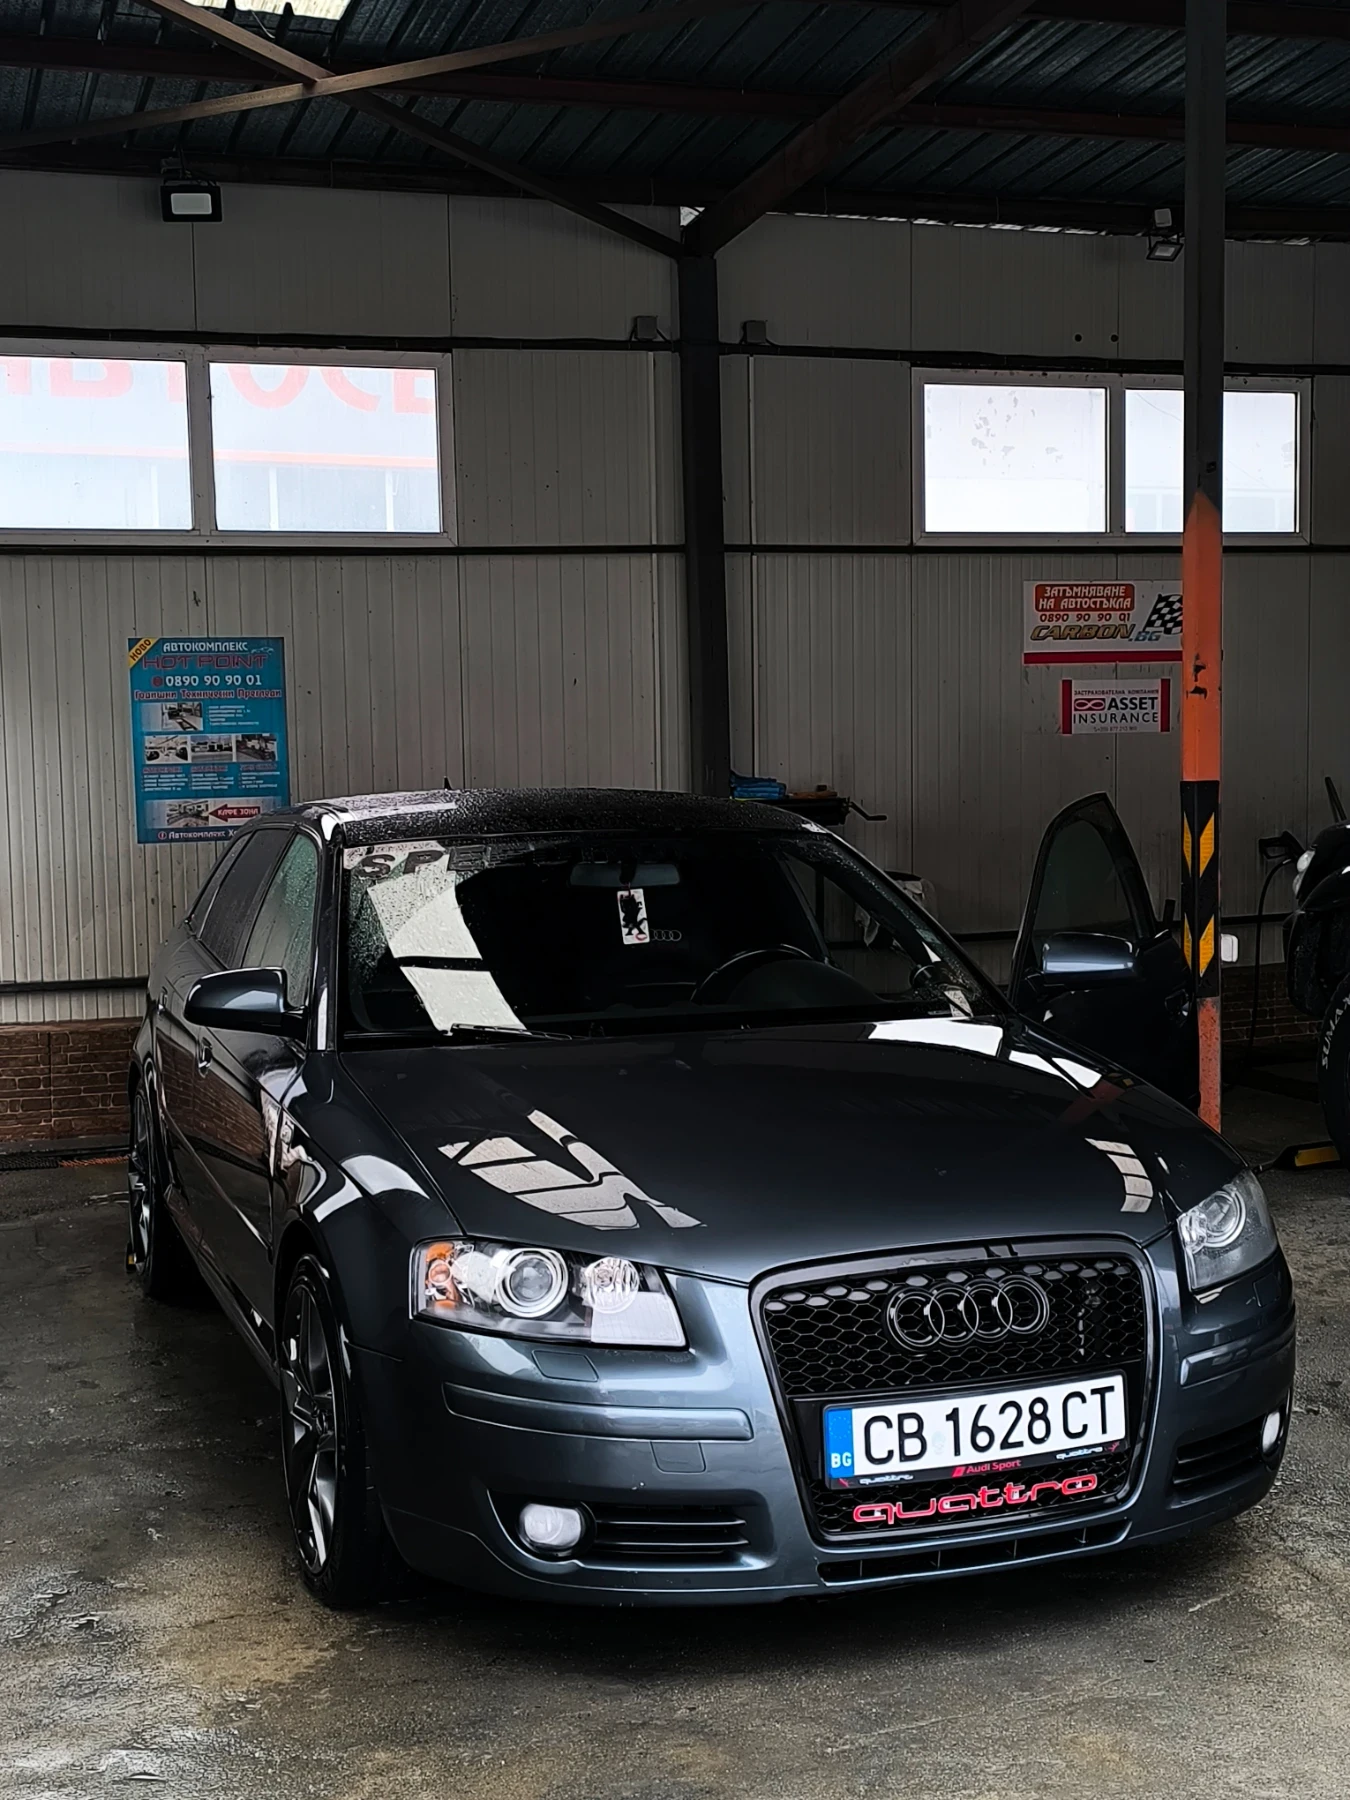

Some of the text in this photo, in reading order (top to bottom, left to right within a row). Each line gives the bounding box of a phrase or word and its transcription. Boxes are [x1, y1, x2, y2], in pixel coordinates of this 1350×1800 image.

[1044, 586, 1126, 597] ЗАТЪМНЯВАНЕ
[1038, 598, 1131, 609] НА АВТОСТЪКЛА
[1039, 613, 1069, 623] 0890
[1076, 613, 1091, 622] 90
[1097, 613, 1112, 622] 90
[129, 638, 152, 662] НОВО
[163, 641, 249, 653] АВТОКОМПЛЕКС
[142, 653, 267, 670] HOT POINT
[165, 674, 262, 687] 0890 90 90 01
[1108, 697, 1158, 710] ASSET
[1073, 712, 1159, 724] INSURANCE
[863, 1385, 1115, 1466] CB 1628 CT
[1056, 1446, 1103, 1460] quattro
[831, 1452, 852, 1469] BG
[966, 1459, 1022, 1475] Audi Sport
[852, 1473, 1098, 1525] quattro
